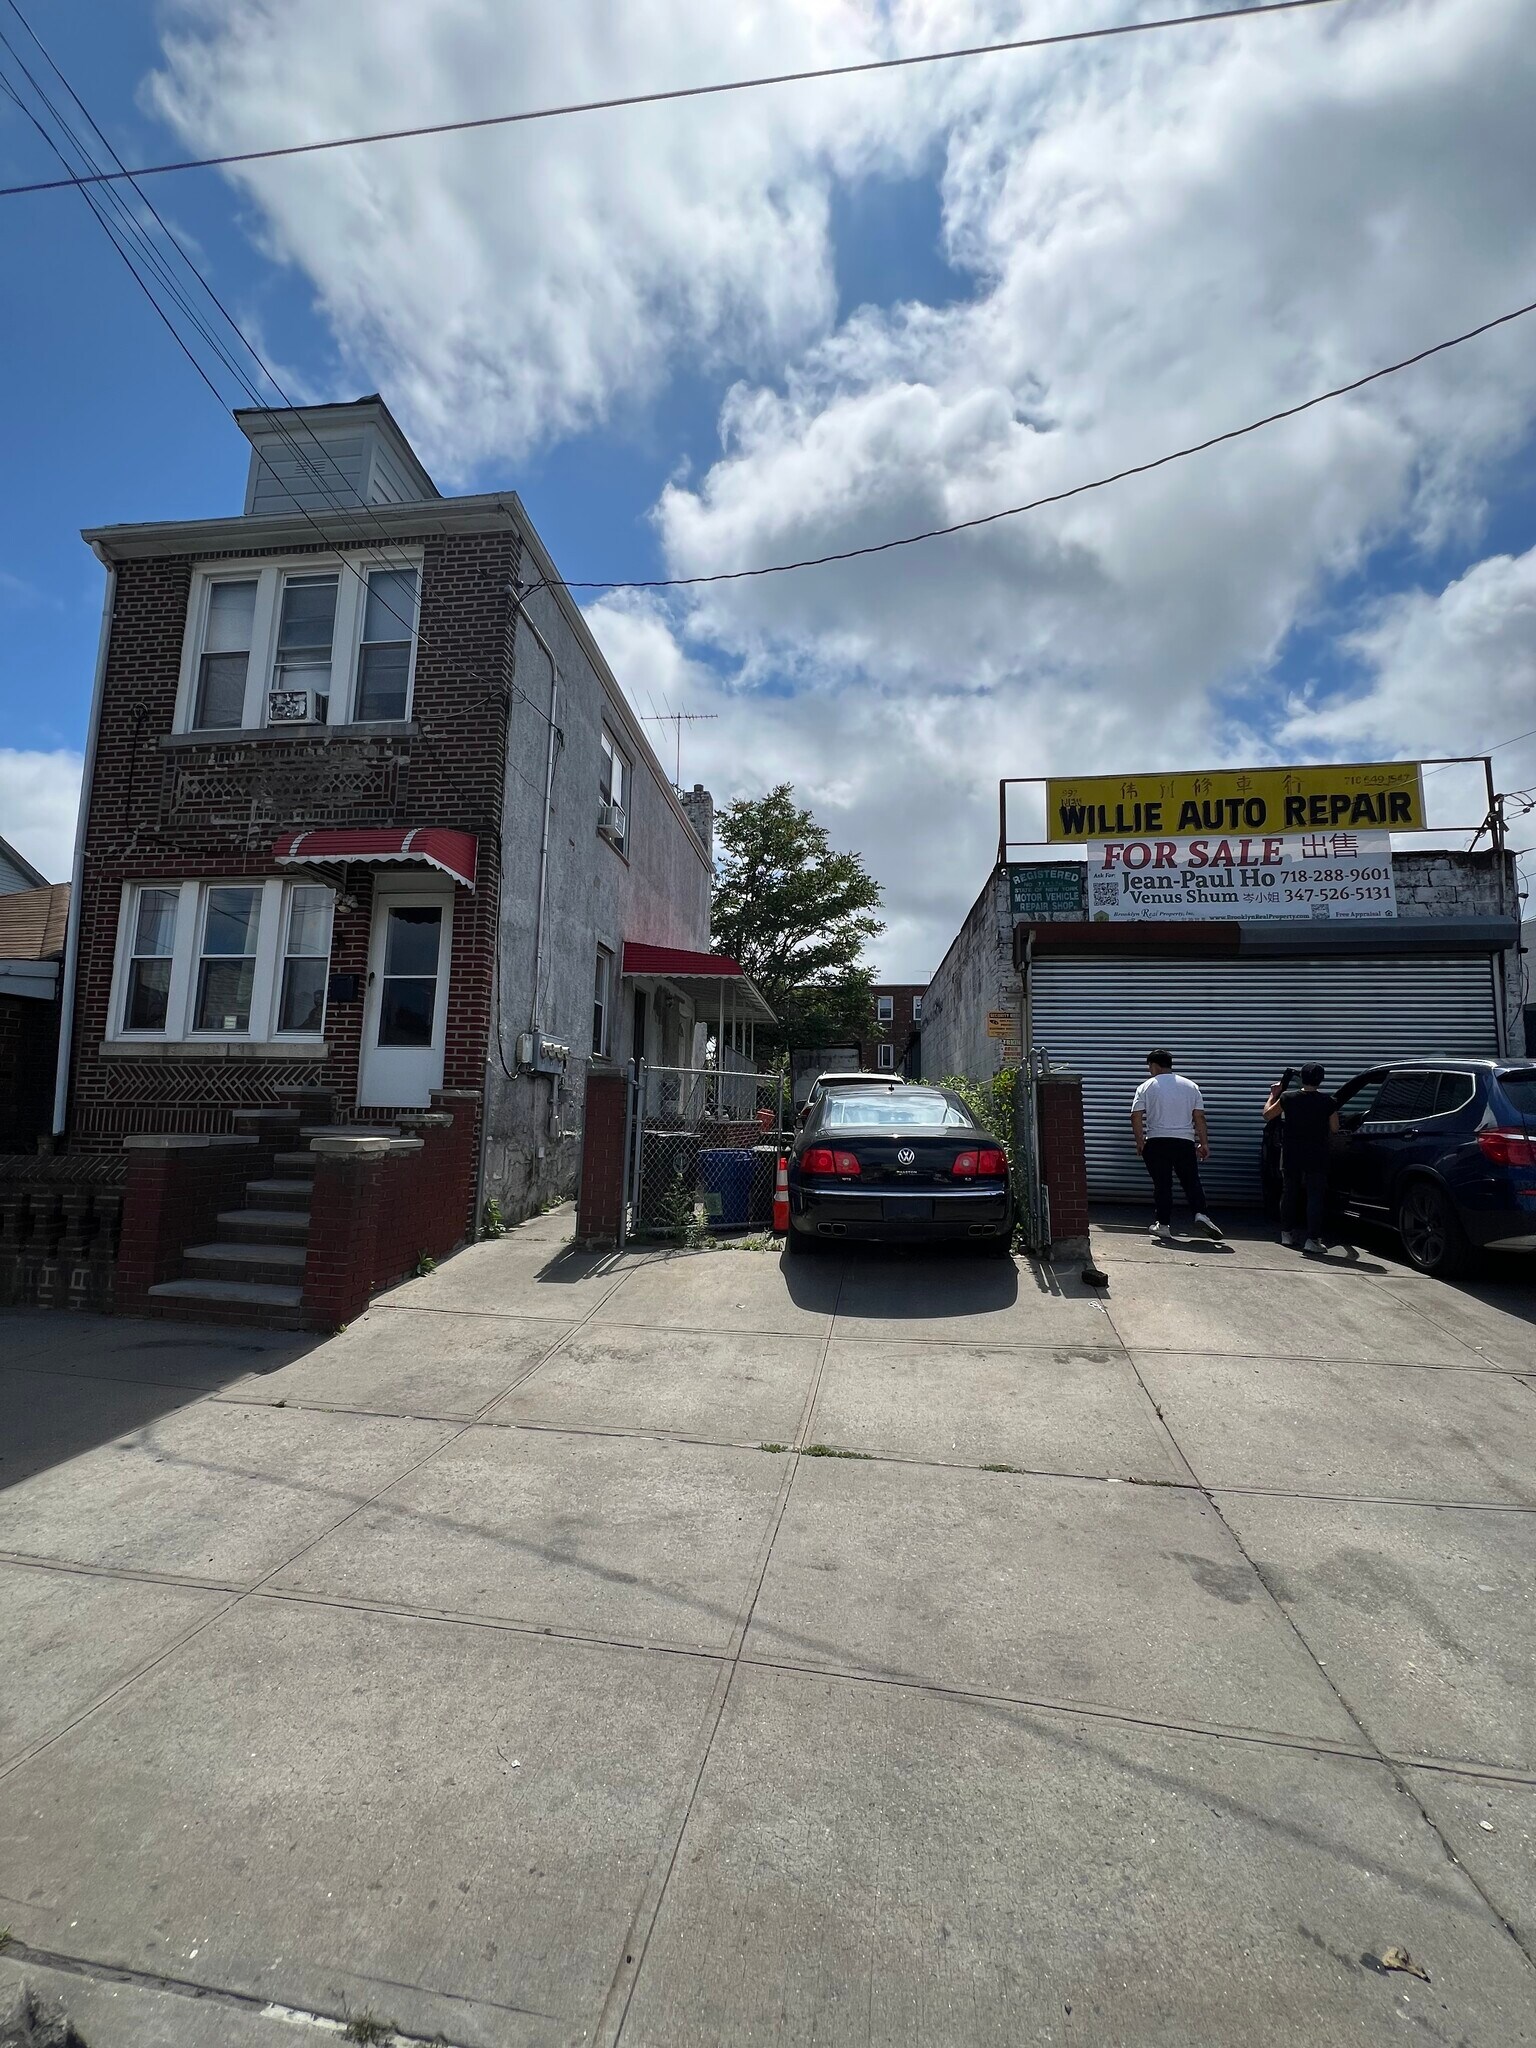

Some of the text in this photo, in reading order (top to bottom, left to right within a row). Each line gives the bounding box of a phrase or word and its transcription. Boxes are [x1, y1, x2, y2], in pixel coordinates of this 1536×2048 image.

[1059, 791, 1413, 835] WILLIE AUTO REPAIR
[1101, 837, 1284, 870] FOR SALE
[1301, 832, 1359, 859] 出售
[1013, 870, 1079, 885] REGISTERED
[1122, 867, 1391, 894] Jean-Paul Ho 718-288-9601
[1014, 891, 1080, 902] MOTOR VEHICLE
[1129, 889, 1240, 904] Venus Shum
[1284, 886, 1392, 902] 347-526-5131
[1020, 902, 1049, 911] REPAIR
